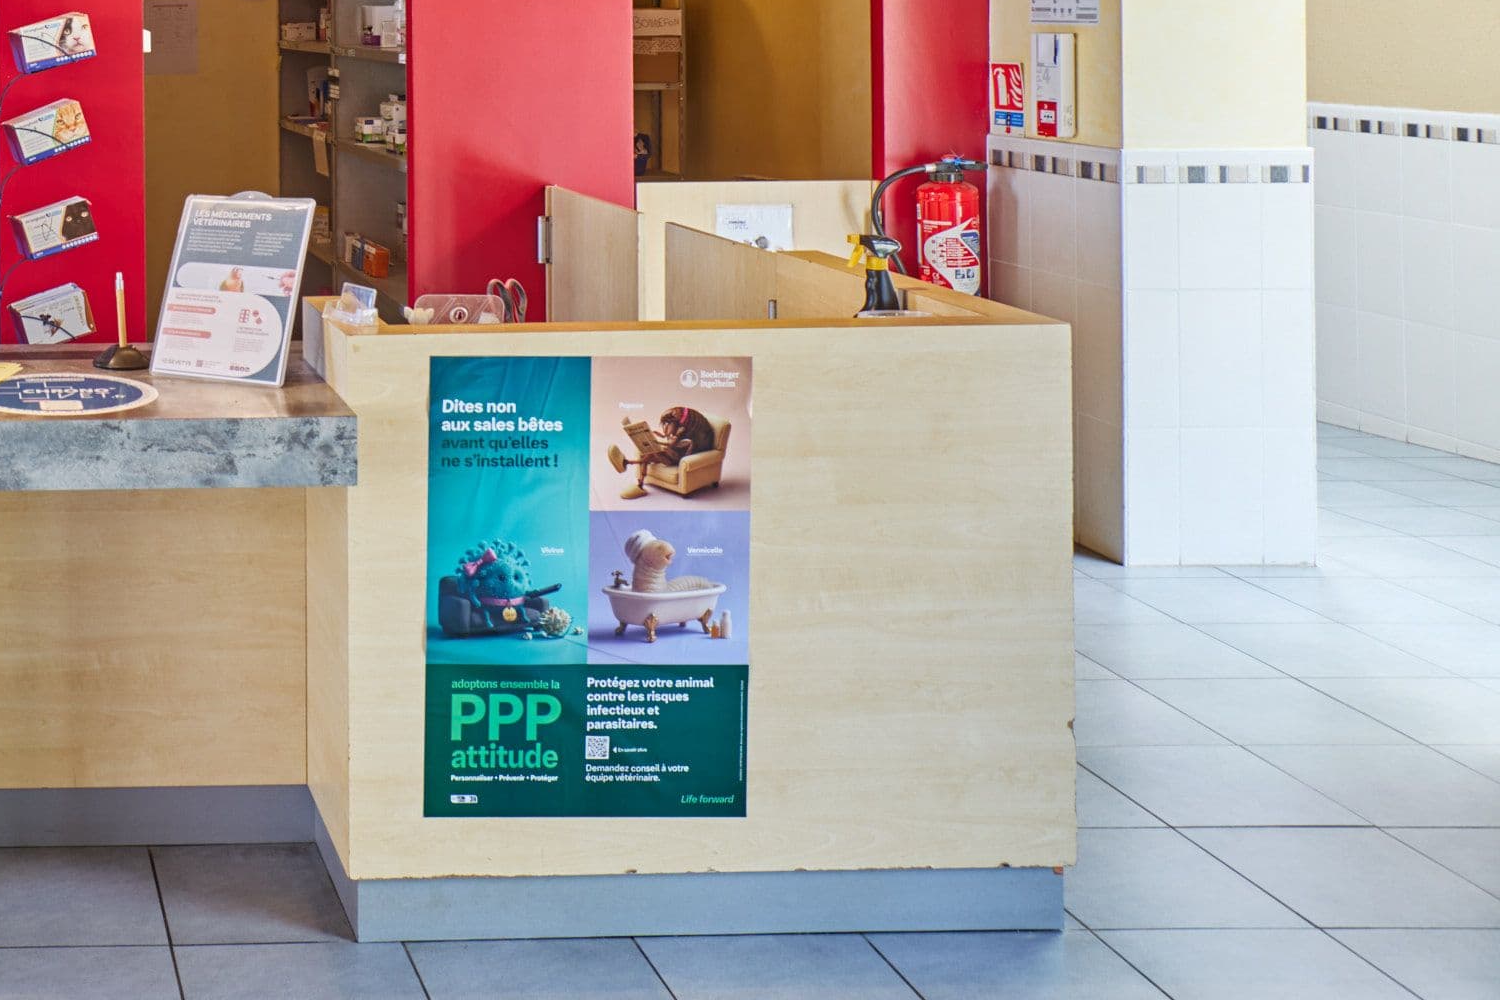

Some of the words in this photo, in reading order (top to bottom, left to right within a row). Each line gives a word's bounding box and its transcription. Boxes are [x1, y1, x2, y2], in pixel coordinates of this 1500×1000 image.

[211, 210, 272, 222] MÉDICAMENTS
[194, 217, 252, 228] VÉTÉRINAIRES
[700, 370, 740, 379] Boehringer
[700, 380, 736, 388] Ingelheim
[442, 398, 484, 414] Dites
[486, 402, 516, 414] non
[441, 420, 471, 432] aux
[474, 416, 516, 432] sales
[518, 416, 564, 432] bêtes
[442, 438, 486, 449] avant
[488, 436, 549, 452] qu'elles
[442, 456, 460, 468] ne
[464, 454, 551, 468] s'installent
[554, 454, 558, 468] !
[452, 679, 498, 690] adoptons
[500, 680, 549, 689] ensemble
[551, 680, 560, 689] la
[586, 676, 640, 690] Protégez
[642, 678, 674, 688] votre
[675, 676, 714, 688] animal
[586, 692, 626, 702] contre
[628, 690, 645, 702] les
[646, 690, 690, 704] risques
[586, 704, 646, 716] infectieux
[646, 706, 660, 716] et
[451, 694, 562, 741] PPP
[586, 718, 658, 732] parasitaires.
[452, 742, 558, 768] attitude
[586, 764, 630, 772] Demandez
[630, 764, 660, 772] conseil
[661, 763, 667, 772] à
[530, 774, 558, 782] Protéger
[585, 772, 614, 783] équipe
[615, 774, 660, 782] vétérinaire.
[681, 794, 698, 804] Life
[699, 794, 735, 804] forward
